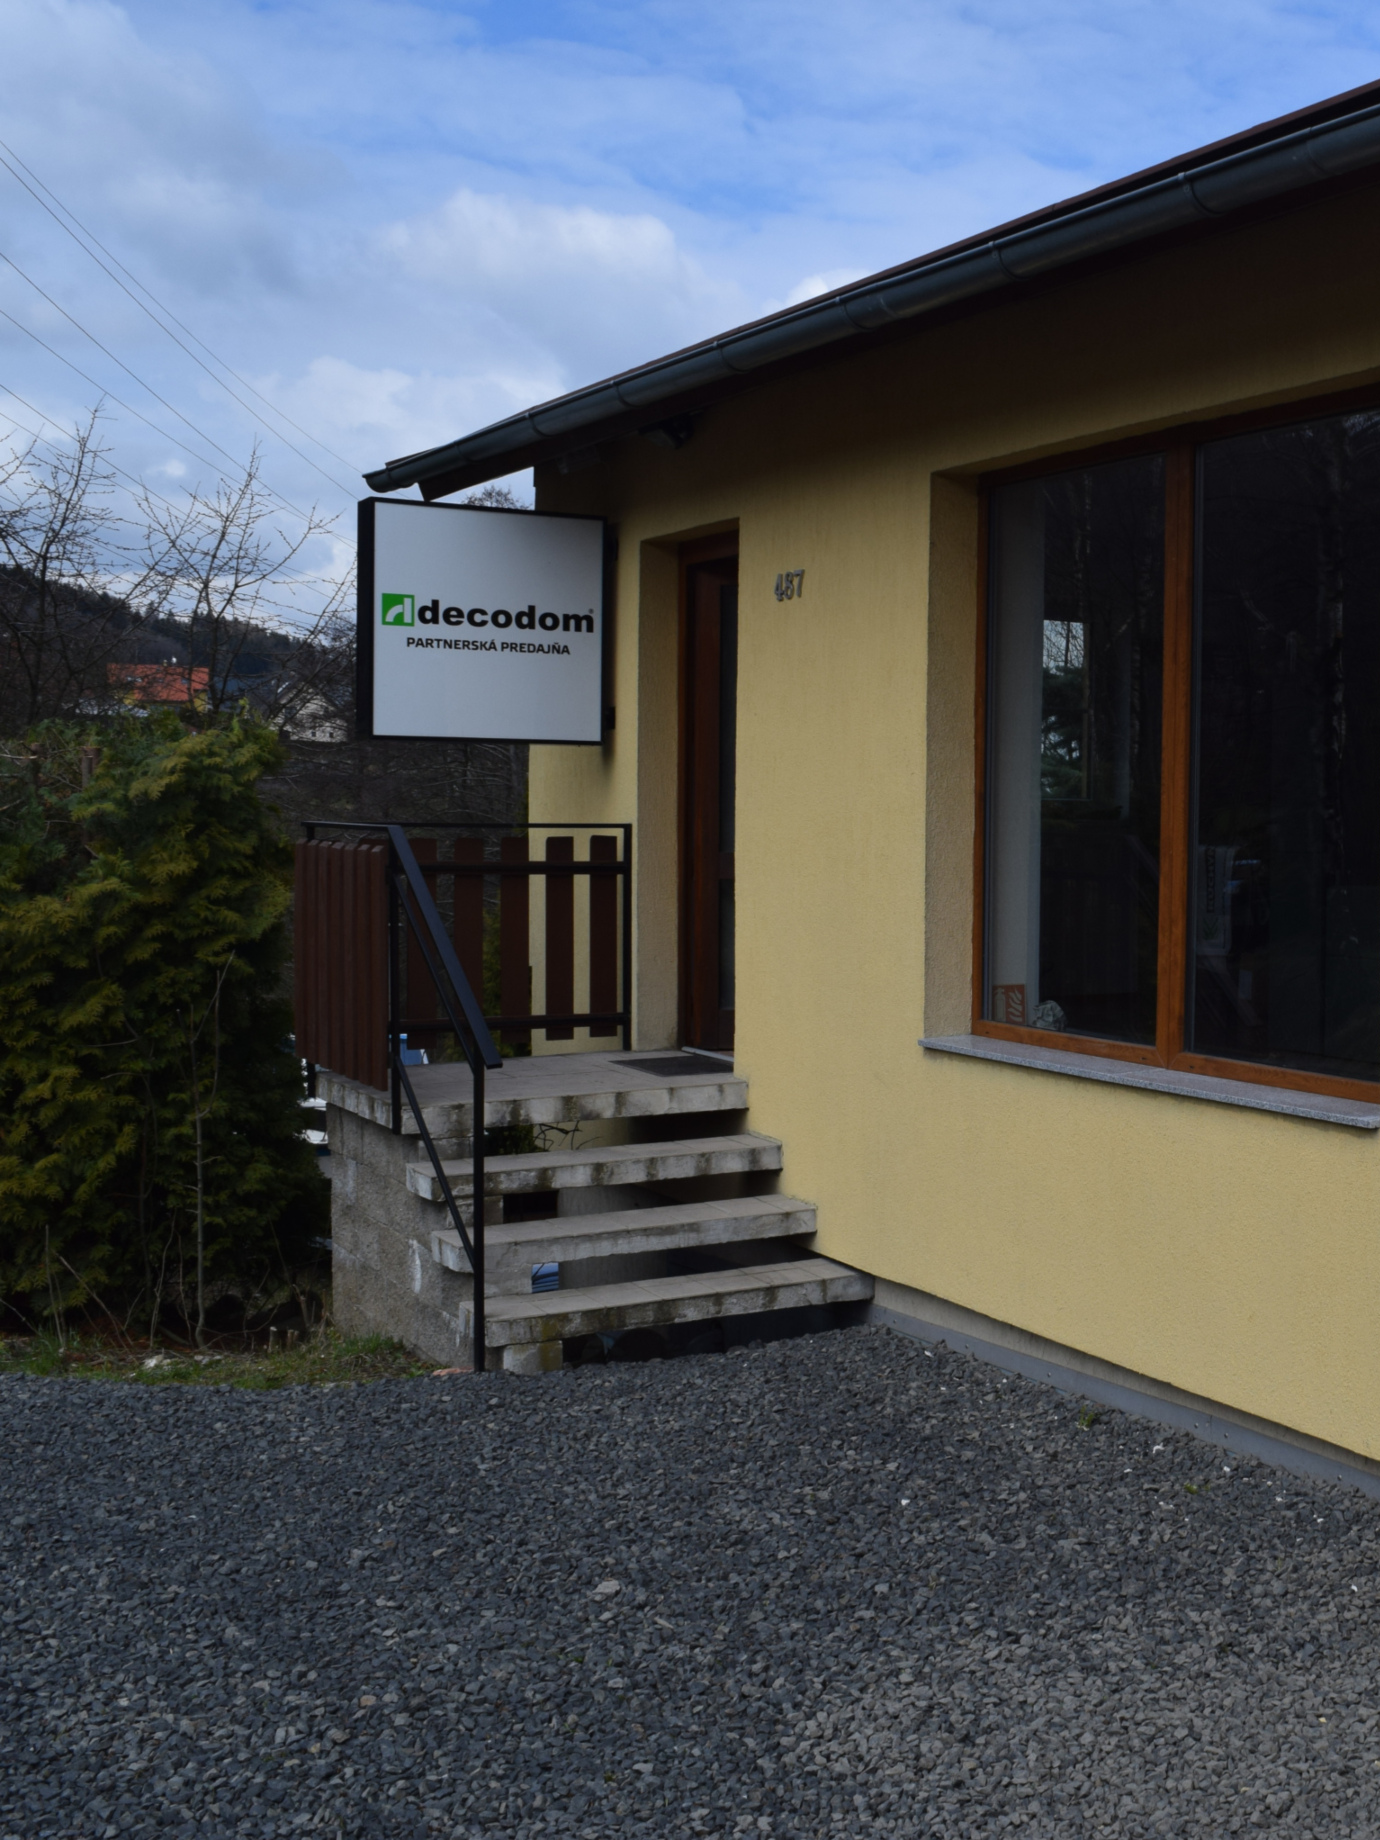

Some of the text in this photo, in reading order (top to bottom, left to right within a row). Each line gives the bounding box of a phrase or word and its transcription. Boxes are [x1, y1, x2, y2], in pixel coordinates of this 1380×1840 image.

[774, 568, 805, 602] 487
[417, 599, 594, 633] decodom
[406, 637, 571, 655] PARTNERSKÁ PREDAJŇA
